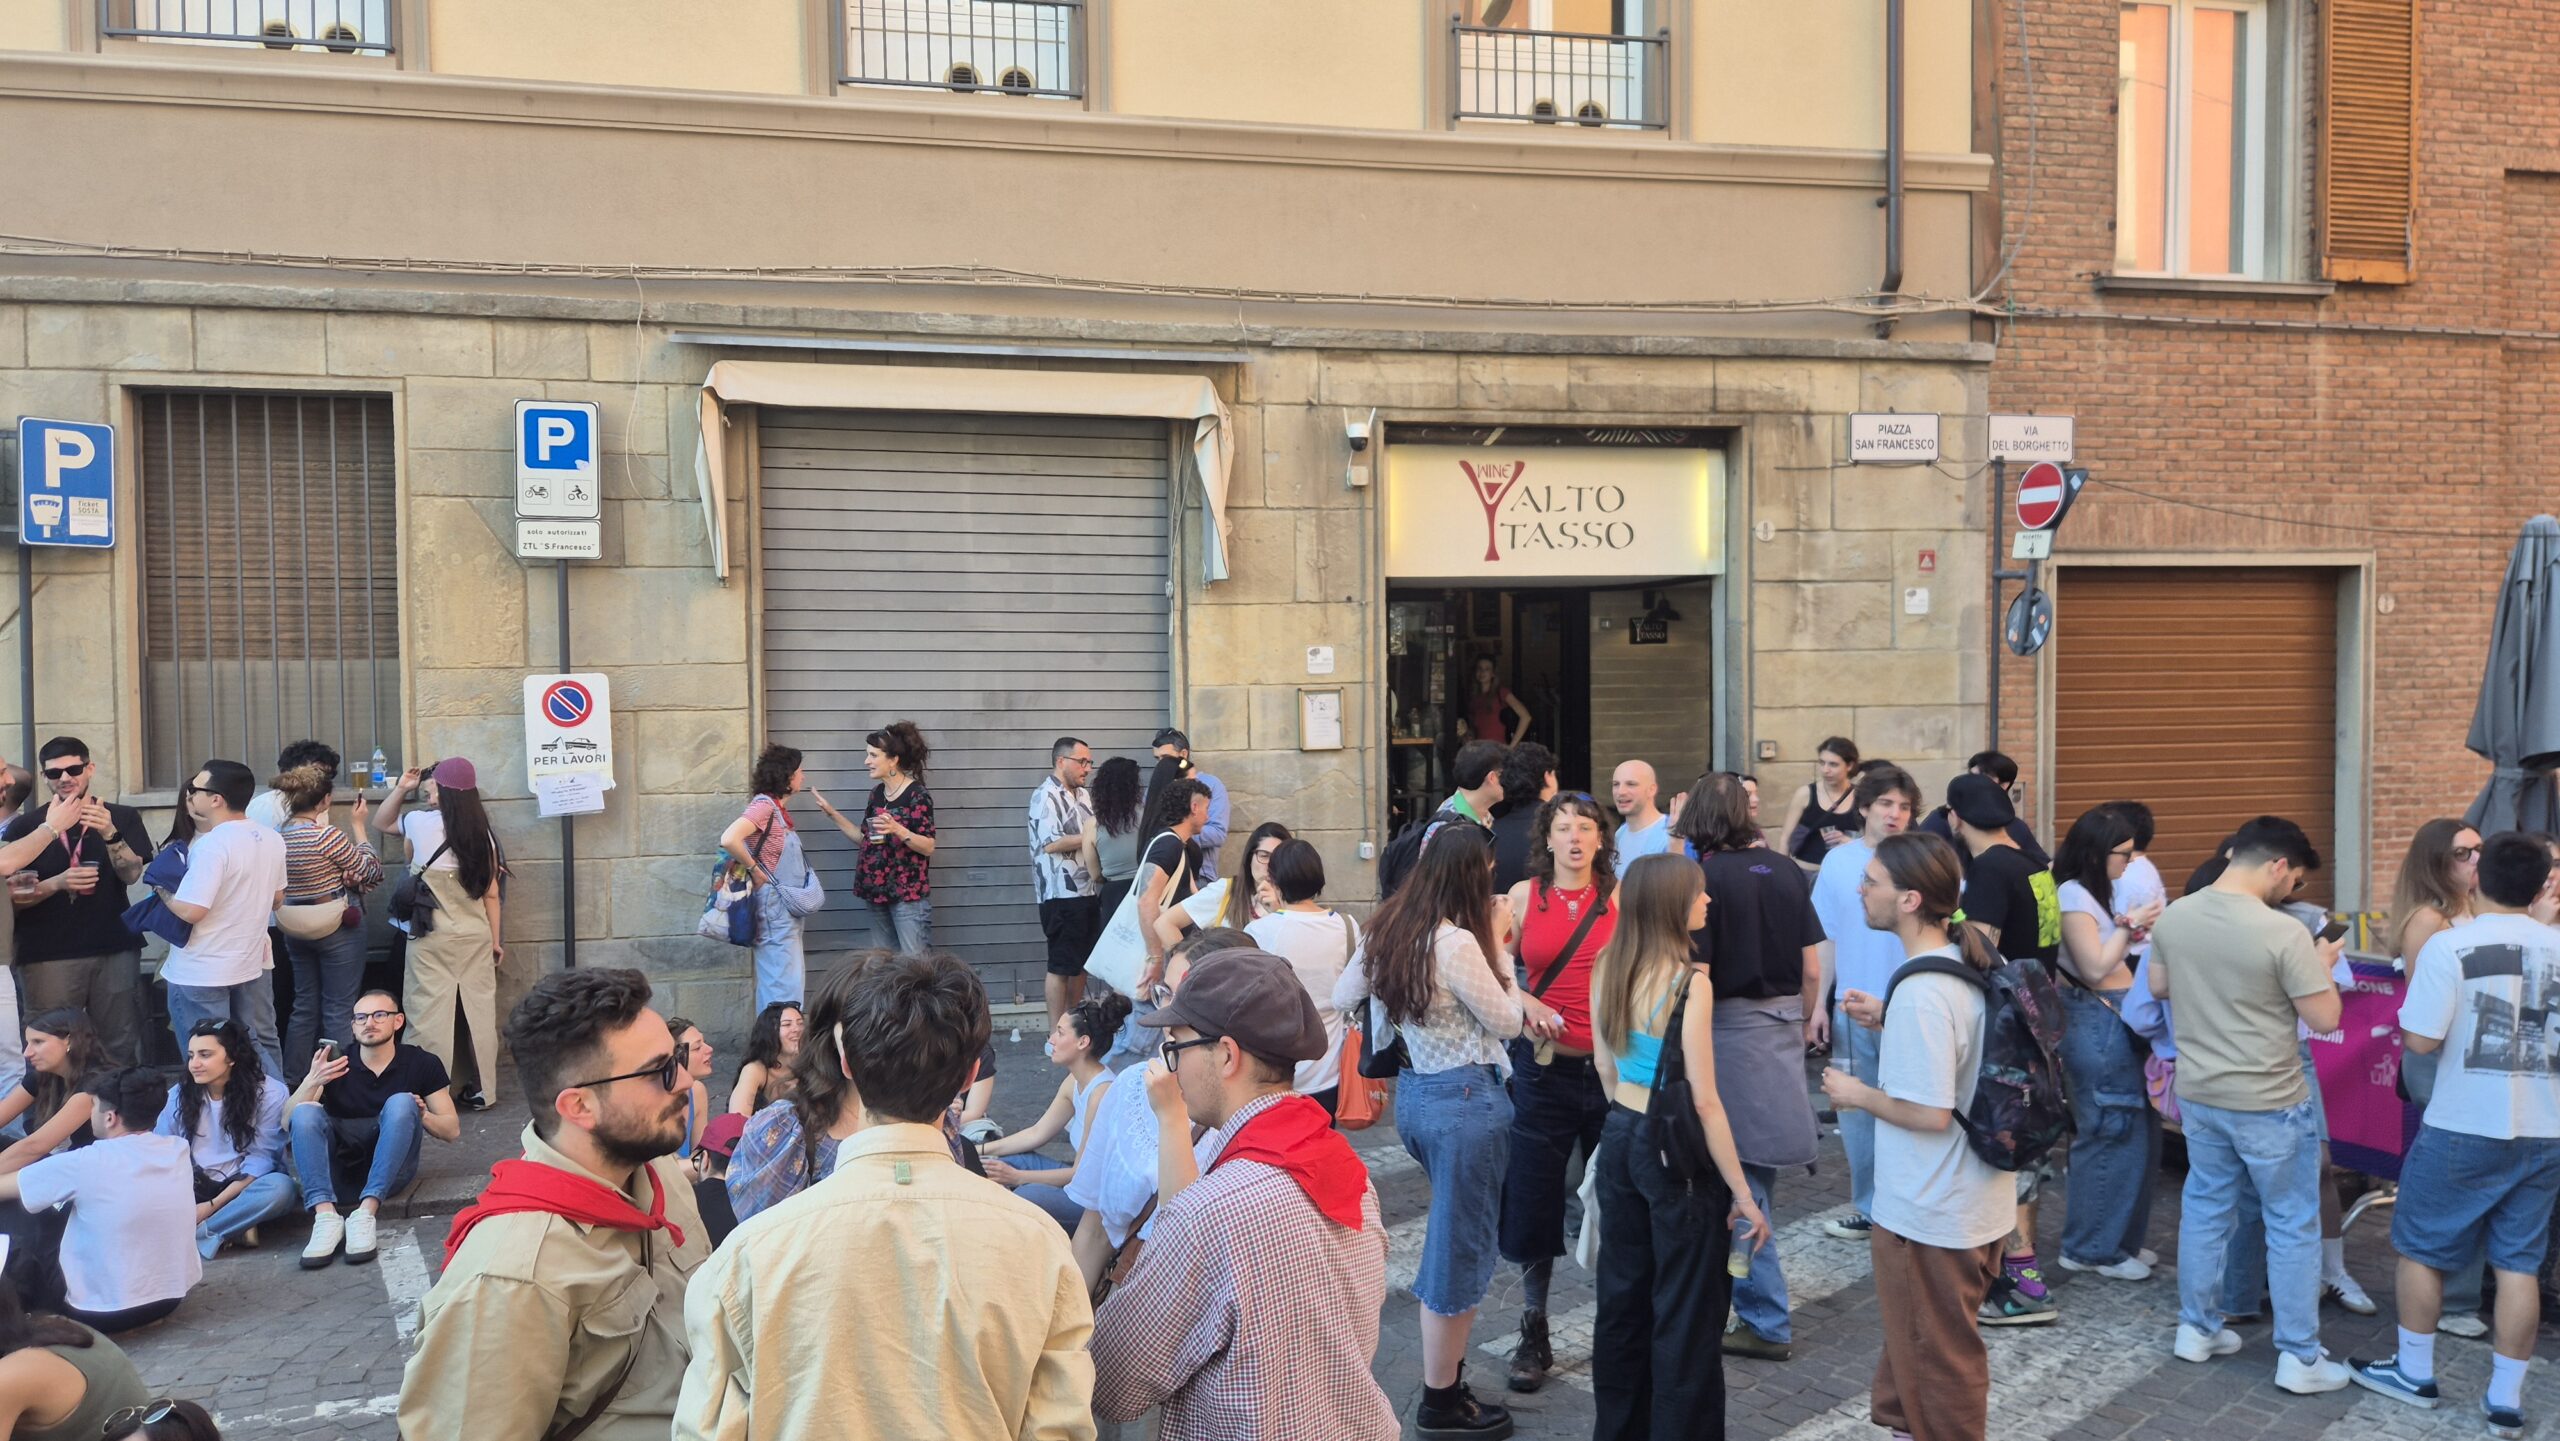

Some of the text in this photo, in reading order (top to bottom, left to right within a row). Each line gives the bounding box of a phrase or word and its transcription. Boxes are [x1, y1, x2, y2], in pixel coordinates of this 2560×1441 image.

[1878, 424, 1912, 435] PIAZZA
[2023, 426, 2038, 436] VIA
[538, 416, 575, 461] P
[1855, 439, 1935, 450] SAN FRANCESCO
[1992, 440, 2069, 451] DEL BORGHETTO
[45, 428, 95, 488] P
[1477, 464, 1512, 479] WINE
[1510, 485, 1625, 513] ALTO
[1500, 522, 1635, 549] TASSO
[534, 754, 606, 766] PER LAVORI
